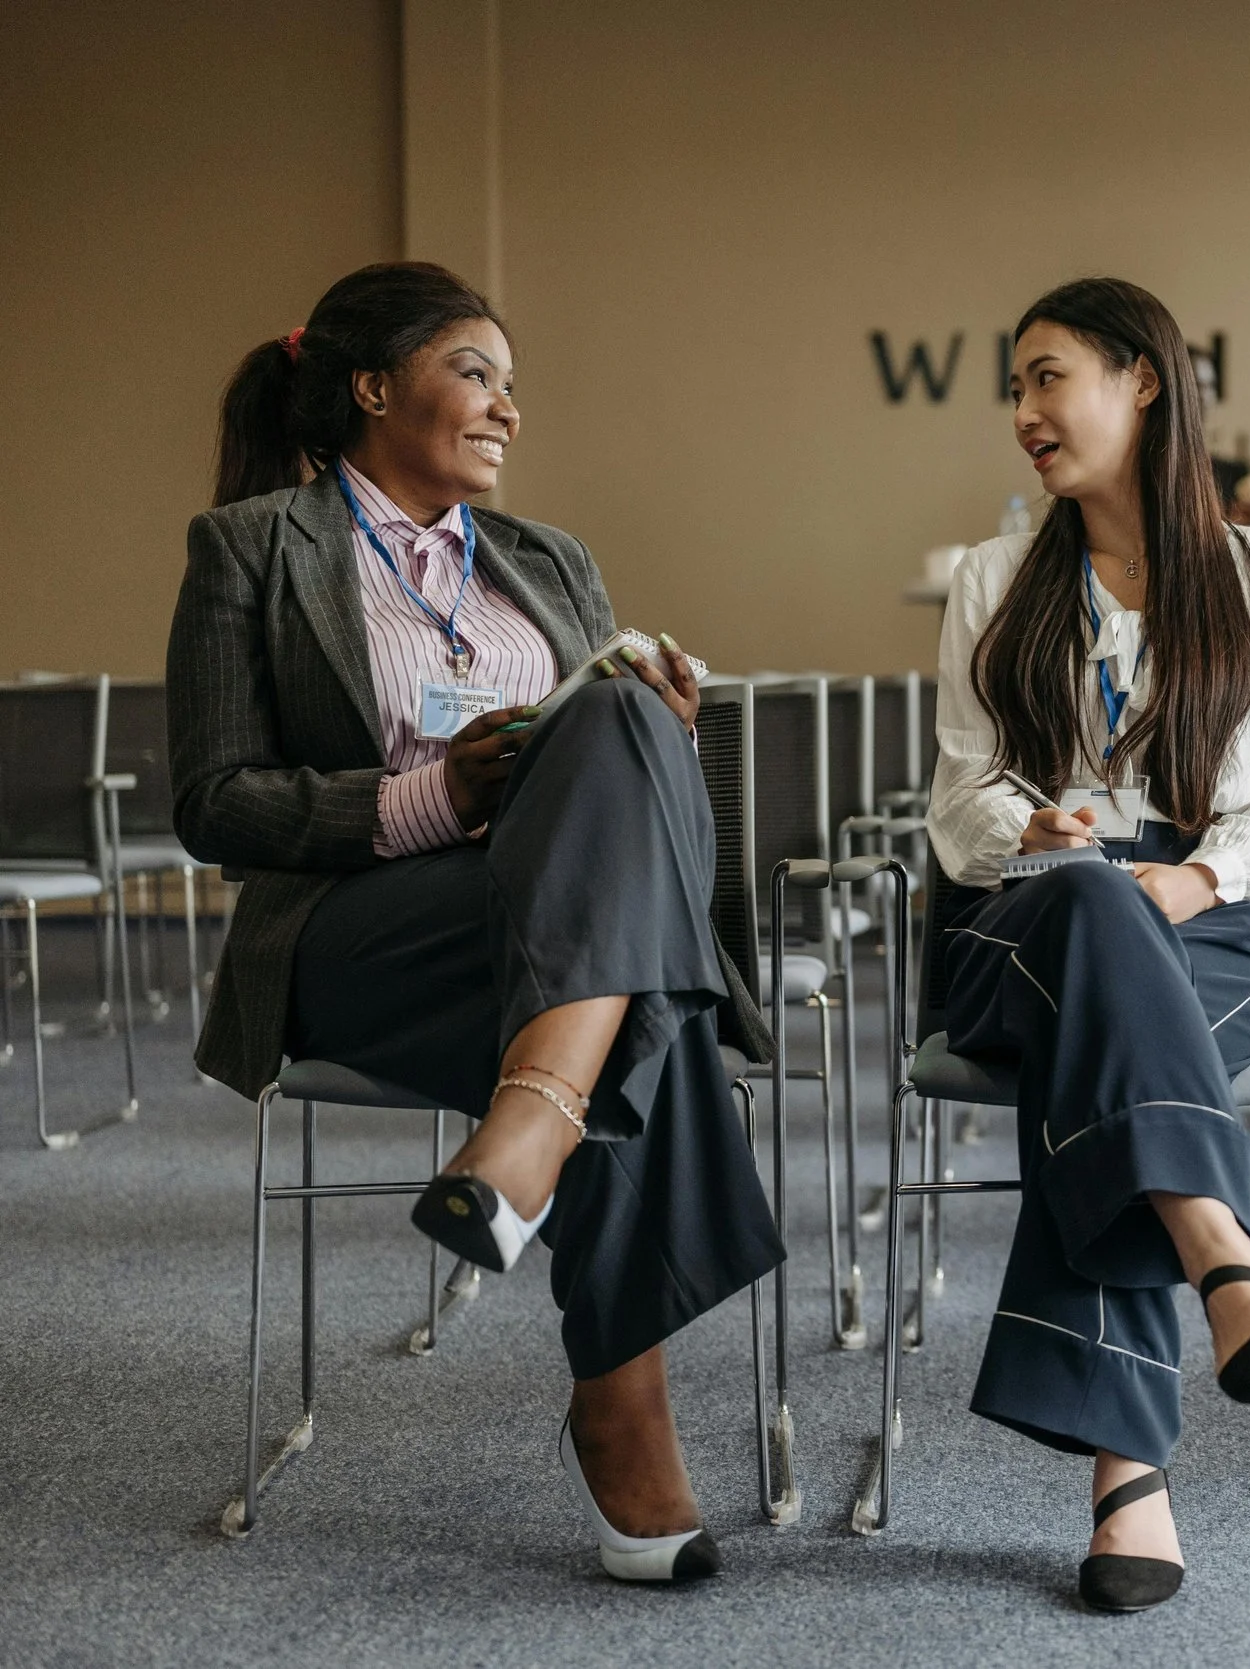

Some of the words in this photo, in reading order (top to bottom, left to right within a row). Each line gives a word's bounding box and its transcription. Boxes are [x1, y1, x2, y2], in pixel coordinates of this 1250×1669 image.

[428, 690, 457, 701] BUSINESS
[458, 693, 496, 705] CONFERENCE
[439, 702, 485, 714] JESSICA
